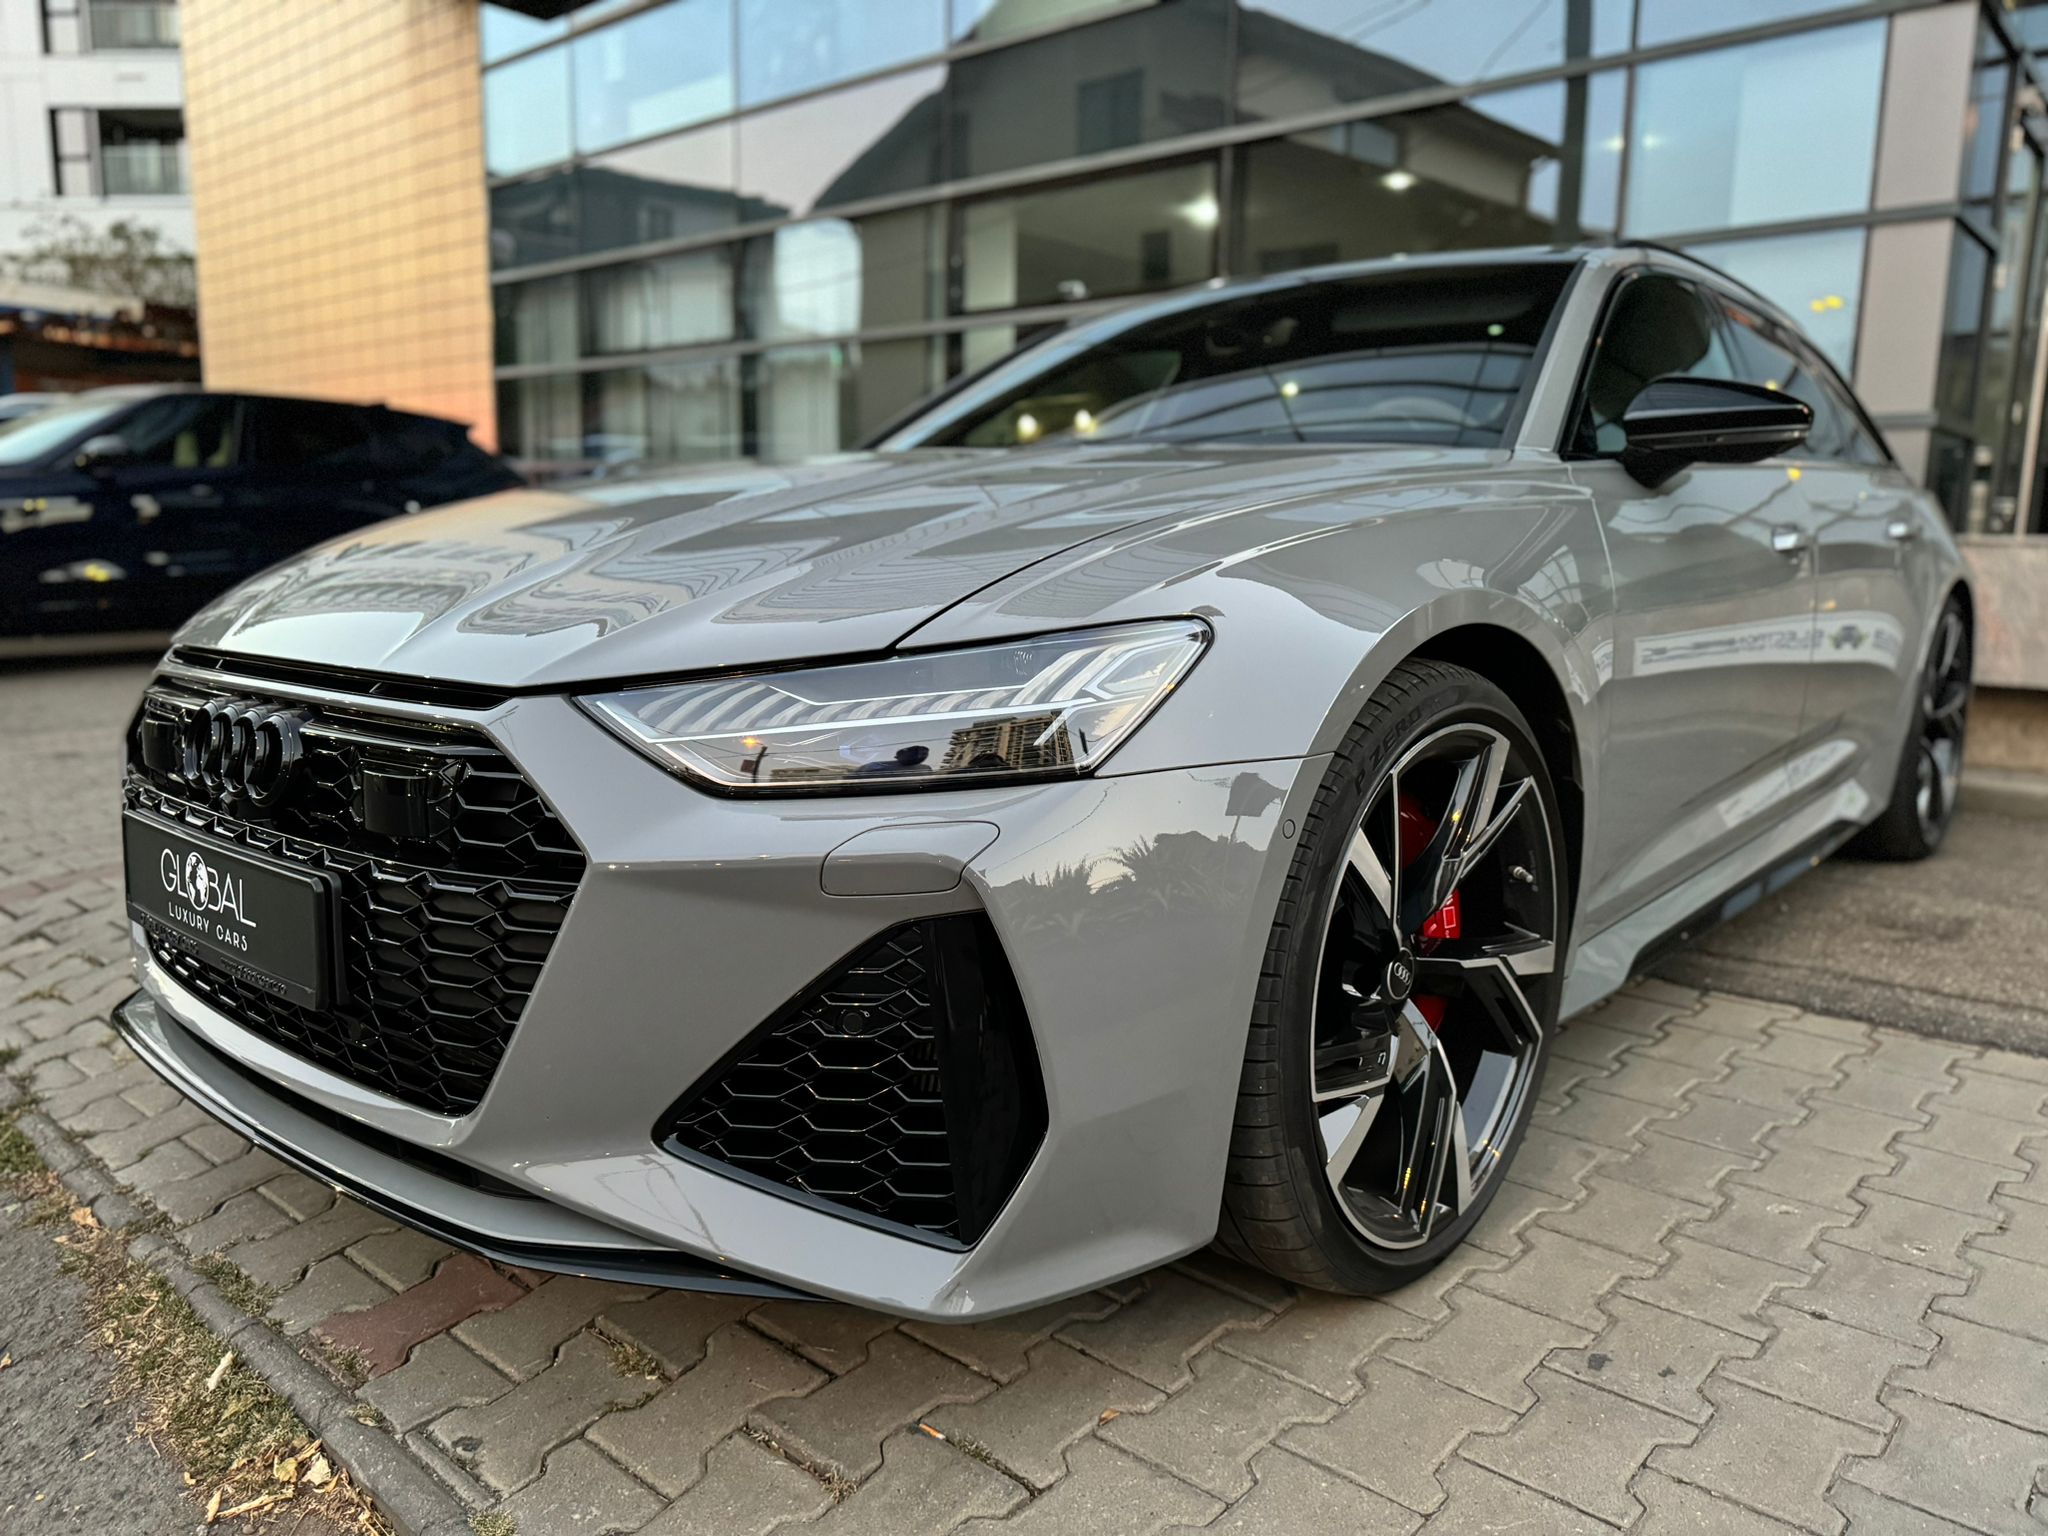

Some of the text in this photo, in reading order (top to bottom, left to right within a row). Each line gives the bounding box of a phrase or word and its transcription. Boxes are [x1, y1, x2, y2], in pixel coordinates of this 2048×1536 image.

[1353, 705, 1423, 796] P ZERO
[160, 848, 257, 928] GLOBAL
[168, 901, 210, 933] LUXURY
[216, 924, 248, 951] CARS
